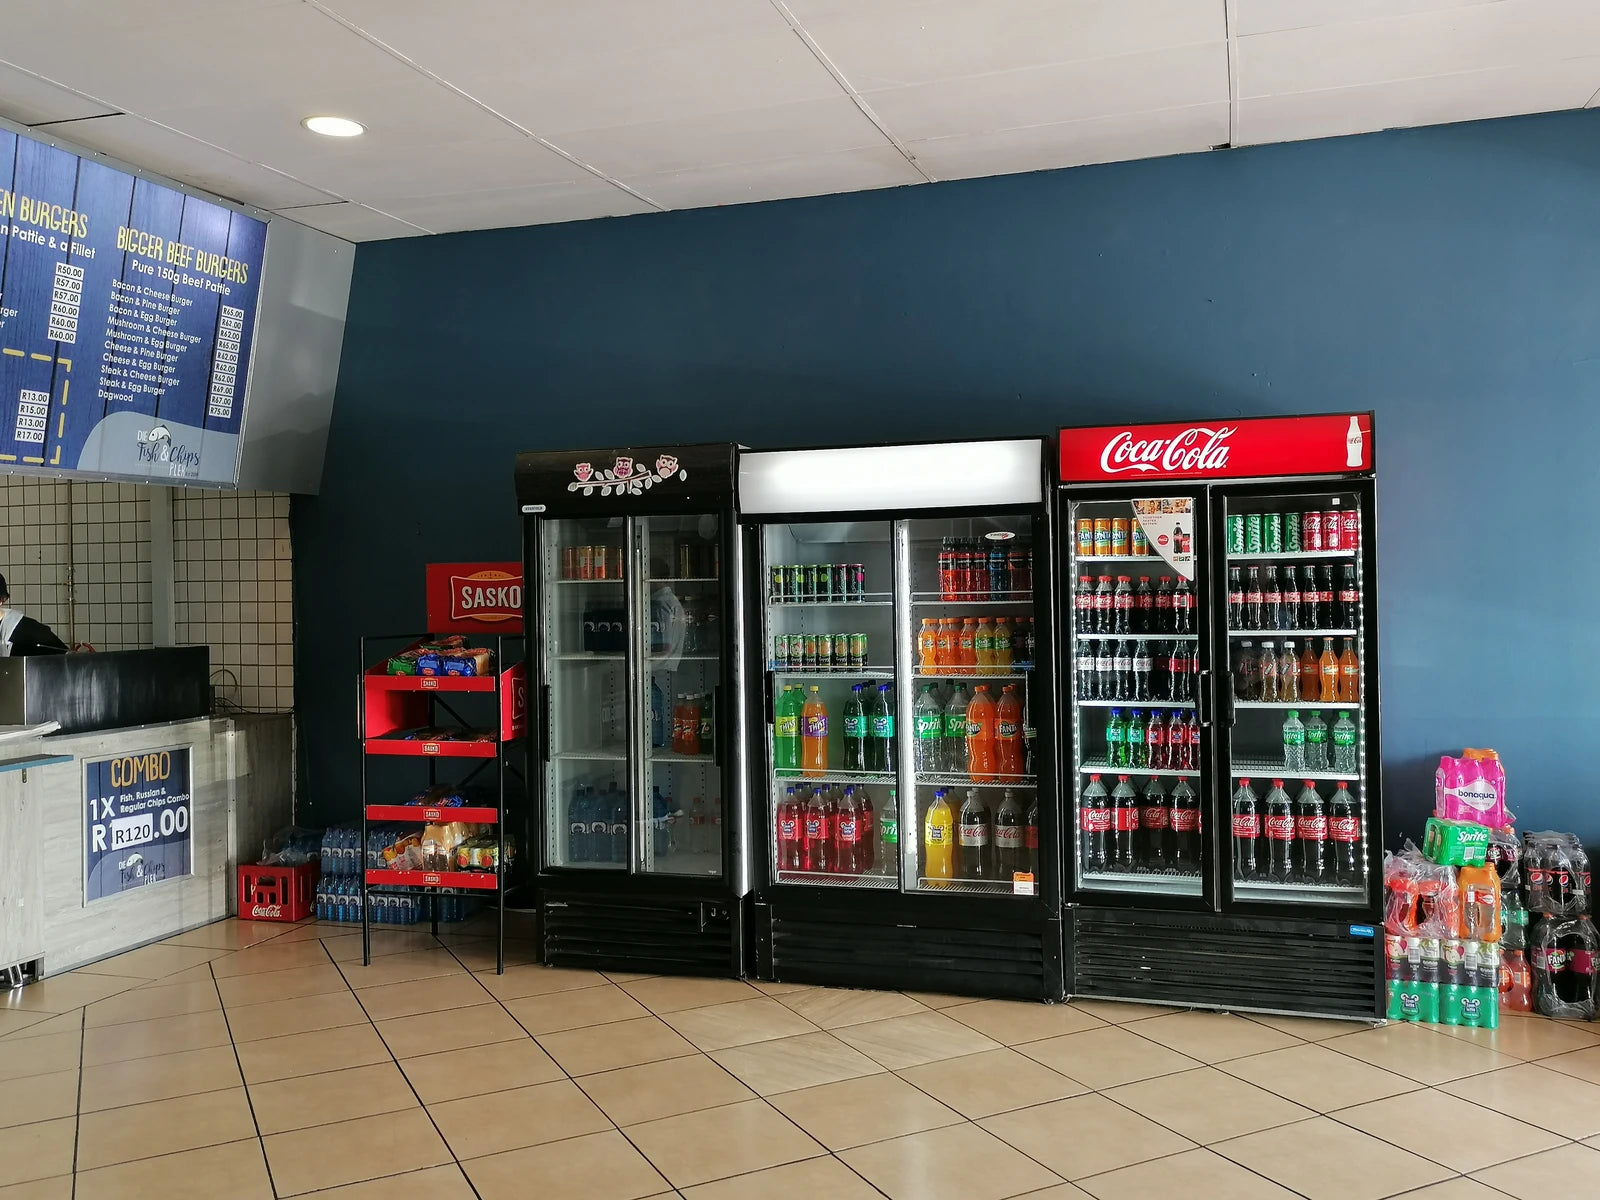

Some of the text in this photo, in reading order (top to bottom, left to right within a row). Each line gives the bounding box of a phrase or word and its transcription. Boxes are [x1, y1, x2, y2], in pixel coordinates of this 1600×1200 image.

[20, 196, 88, 239] BURGERS
[12, 225, 46, 245] Pattie
[48, 236, 56, 249] &
[60, 242, 68, 251] a
[71, 242, 95, 259] Fillet
[116, 226, 248, 284] BIGGER BEEF BURGERS
[57, 264, 82, 278] R50.00
[132, 259, 231, 295] Pure 150g Beef Pattie
[56, 277, 81, 290] R57.00
[54, 290, 79, 303] R57.00
[112, 279, 193, 307] Bacon & Cheese Burger
[53, 304, 77, 316] R60.00
[110, 291, 180, 315] Bacon & Pine Burger
[109, 303, 178, 327] Bacon & Egg Burger
[223, 307, 243, 319] R65.00
[51, 317, 76, 329] R60.00
[107, 316, 202, 344] Mushroom & Cheese Burger
[222, 318, 241, 330] R62.00
[49, 330, 74, 342] R60.00
[105, 328, 143, 344] Mushroom
[150, 338, 164, 349] Egg
[165, 340, 187, 353] Burger
[220, 330, 240, 340] R62.00
[104, 340, 132, 353] Cheese
[140, 348, 155, 358] Pine
[156, 350, 178, 362] Burger
[219, 340, 238, 351] R65.00
[102, 353, 130, 365] Cheese
[138, 359, 152, 370] Egg
[153, 362, 176, 374] Burger
[217, 351, 237, 362] R62.00
[216, 362, 235, 373] R62.00
[101, 364, 180, 387] Steak & Cheese Burger
[214, 373, 234, 384] R62.00
[99, 377, 166, 396] Steak & Egg Burger
[22, 392, 48, 402] R13.00
[98, 389, 133, 402] Dagwood
[20, 405, 46, 415] R15.00
[210, 406, 230, 416] R75.00
[18, 417, 44, 428] R13.00
[16, 430, 43, 441] R17.00
[137, 441, 199, 467] Fish & Chips
[1100, 427, 1238, 473] Coca-Cola
[1233, 517, 1244, 553] Sprite
[1271, 516, 1281, 553] Sprite
[461, 585, 522, 609] SASKO
[948, 717, 966, 731] Spr
[424, 744, 438, 752] SASKO
[111, 751, 170, 788] COMBO
[120, 787, 166, 803] Fish, Russian &
[1458, 789, 1495, 800] bonaqua
[120, 793, 190, 813] Regular Chips Combo
[115, 824, 150, 845] R120
[1457, 831, 1487, 842] Sprite
[136, 865, 144, 878] &
